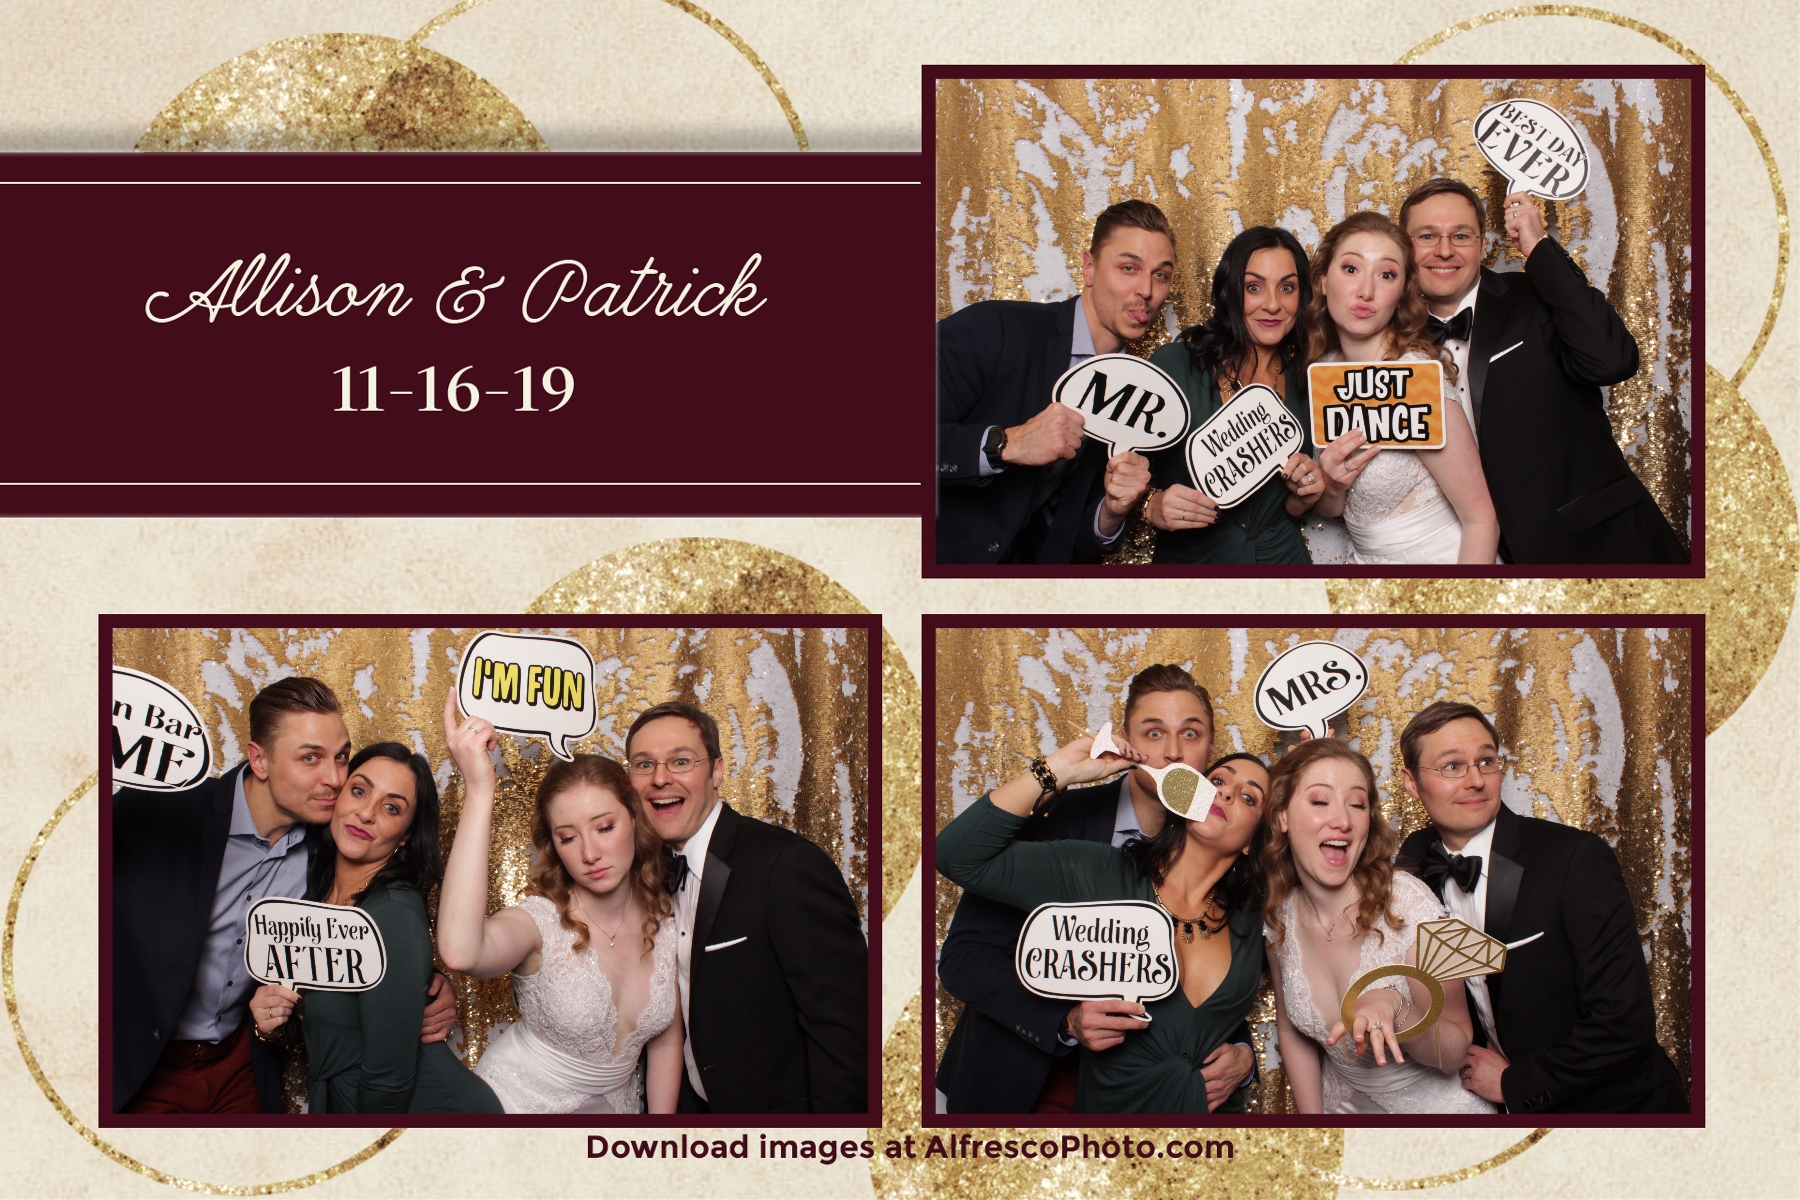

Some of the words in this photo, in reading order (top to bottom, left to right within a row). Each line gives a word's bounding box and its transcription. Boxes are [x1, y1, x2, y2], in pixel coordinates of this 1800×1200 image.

[1477, 118, 1570, 197] EVER
[1499, 102, 1552, 142] BEST
[1547, 136, 1587, 167] DAY
[1076, 369, 1167, 439] MR.
[1333, 366, 1414, 402] JUST
[1200, 402, 1272, 458] Wedding
[1323, 404, 1432, 444] DANCE
[1203, 413, 1297, 499] CRASHERS
[472, 655, 521, 705] I'M
[526, 665, 585, 712] FUN
[1265, 660, 1362, 716] MRS.
[144, 703, 203, 740] Bar
[254, 914, 322, 945] Happily
[326, 917, 369, 940] Ever
[1052, 914, 1150, 952] Wedding
[264, 944, 367, 985] AFTER
[1025, 947, 1172, 985] CRASHERS
